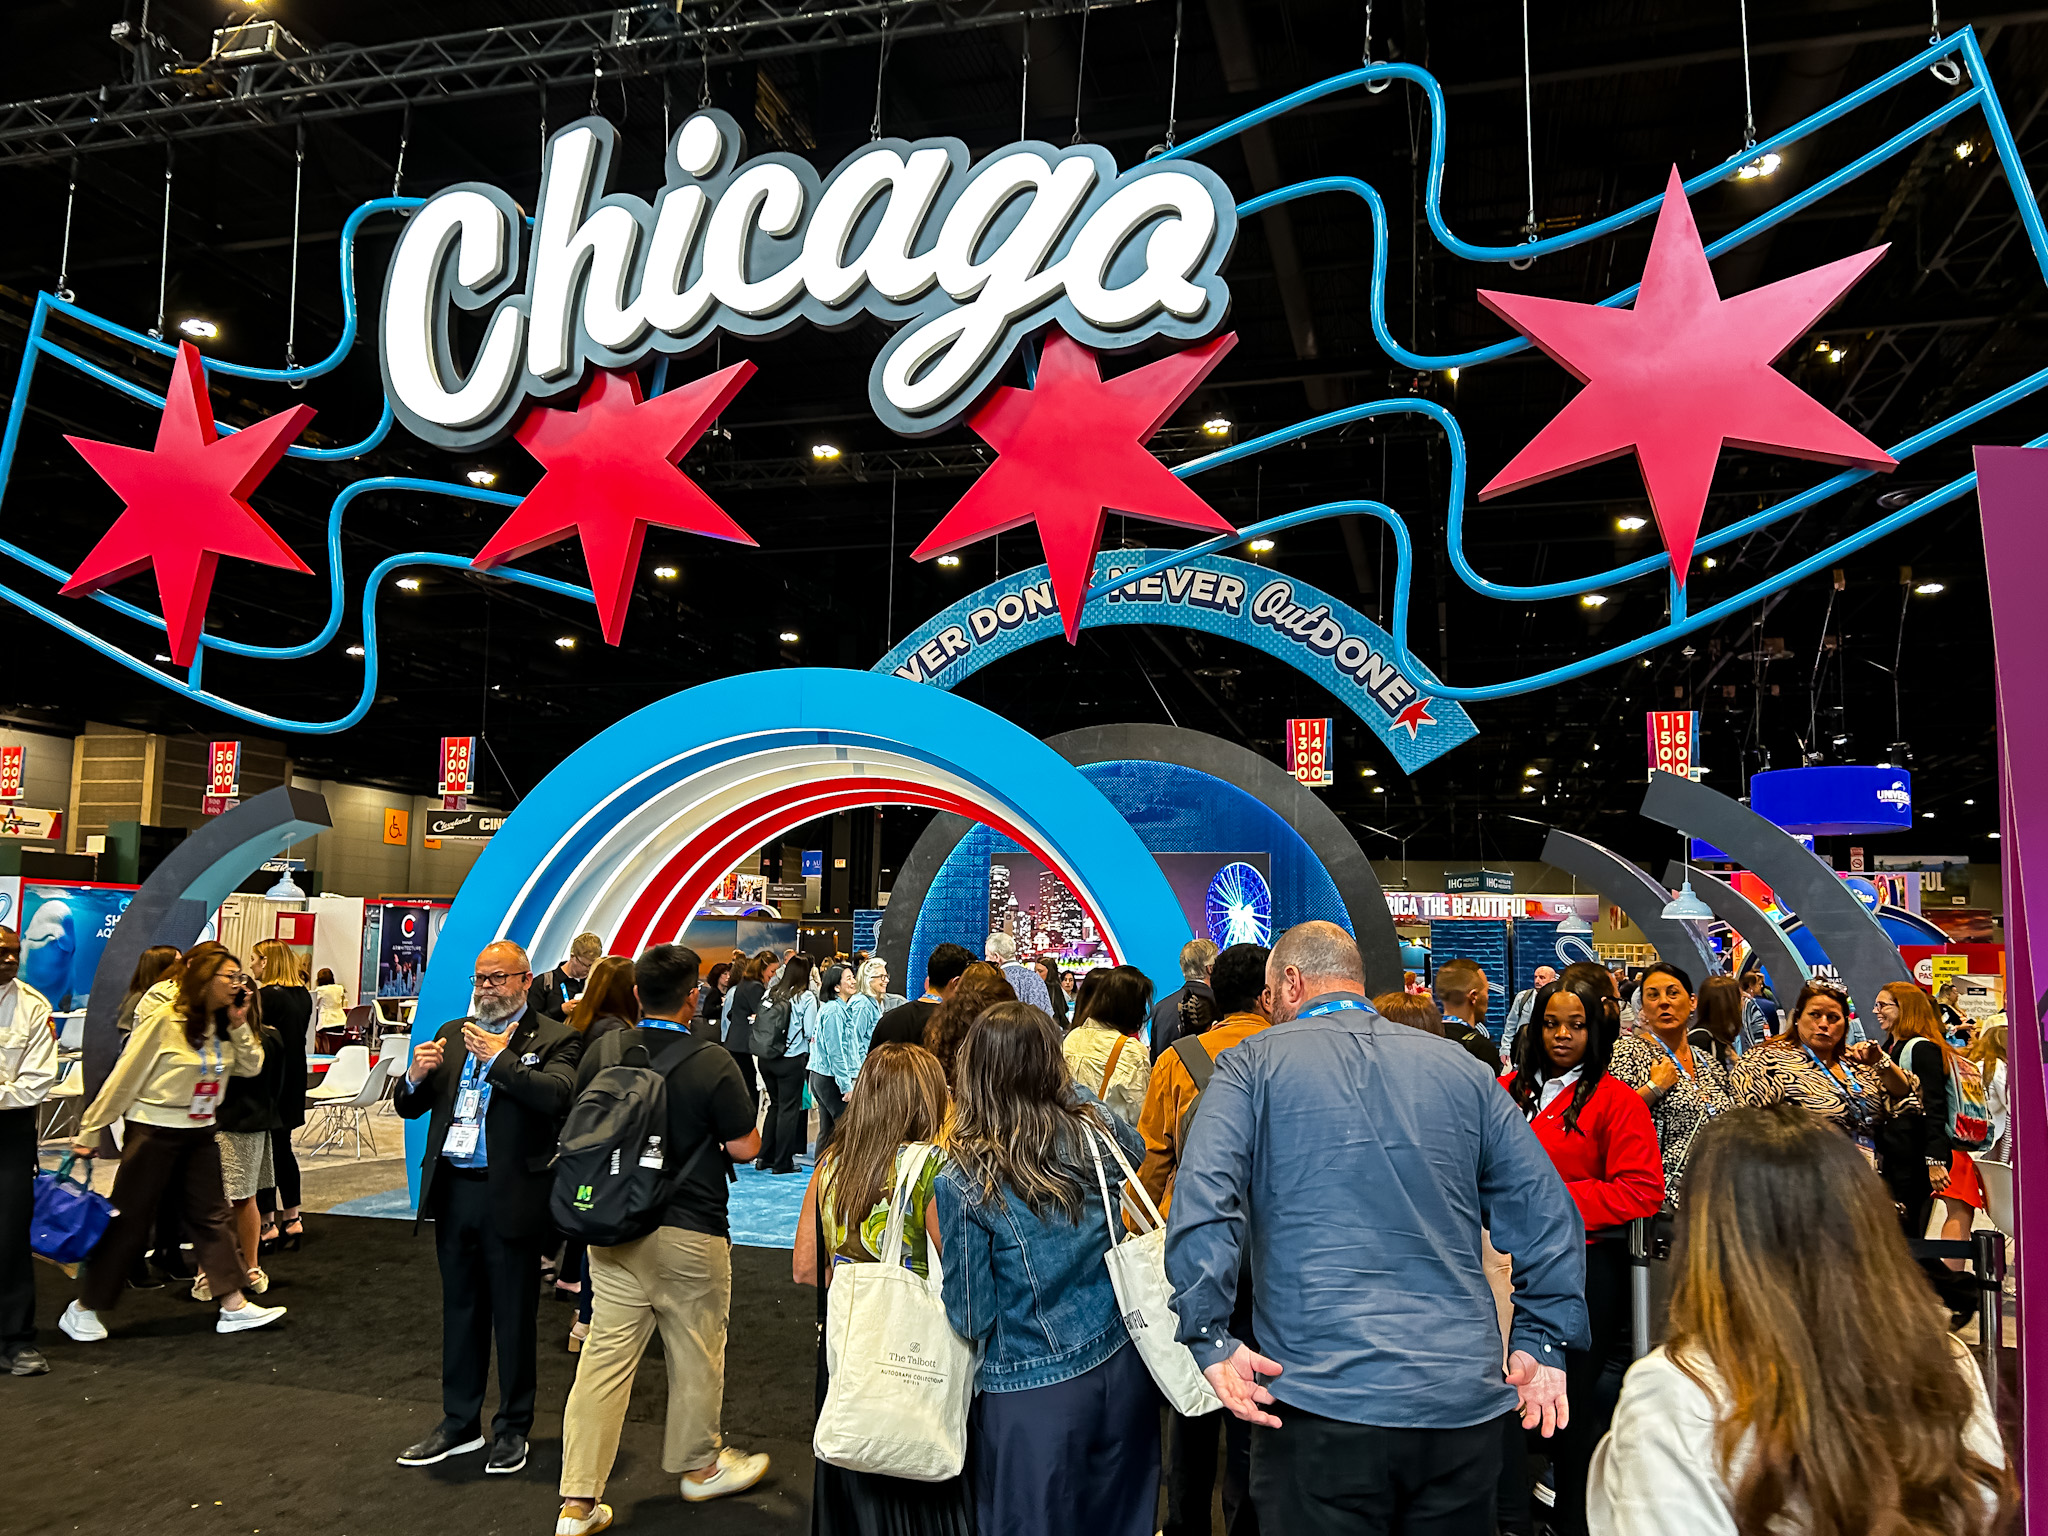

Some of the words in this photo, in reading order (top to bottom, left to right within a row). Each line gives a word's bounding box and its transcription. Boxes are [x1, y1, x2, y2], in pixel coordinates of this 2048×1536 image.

[383, 113, 1218, 428] Chicago
[968, 580, 1061, 646] DON
[432, 814, 473, 833] Cleveland
[1448, 878, 1463, 889] IHG
[1486, 877, 1498, 889] IHG
[1421, 896, 1450, 916] THE
[1451, 897, 1529, 918] BEAUTIFUL
[95, 928, 116, 939] AQ
[889, 1352, 906, 1362] The
[907, 1355, 936, 1368] Talbott
[881, 1369, 912, 1379] AUTOGRAPH
